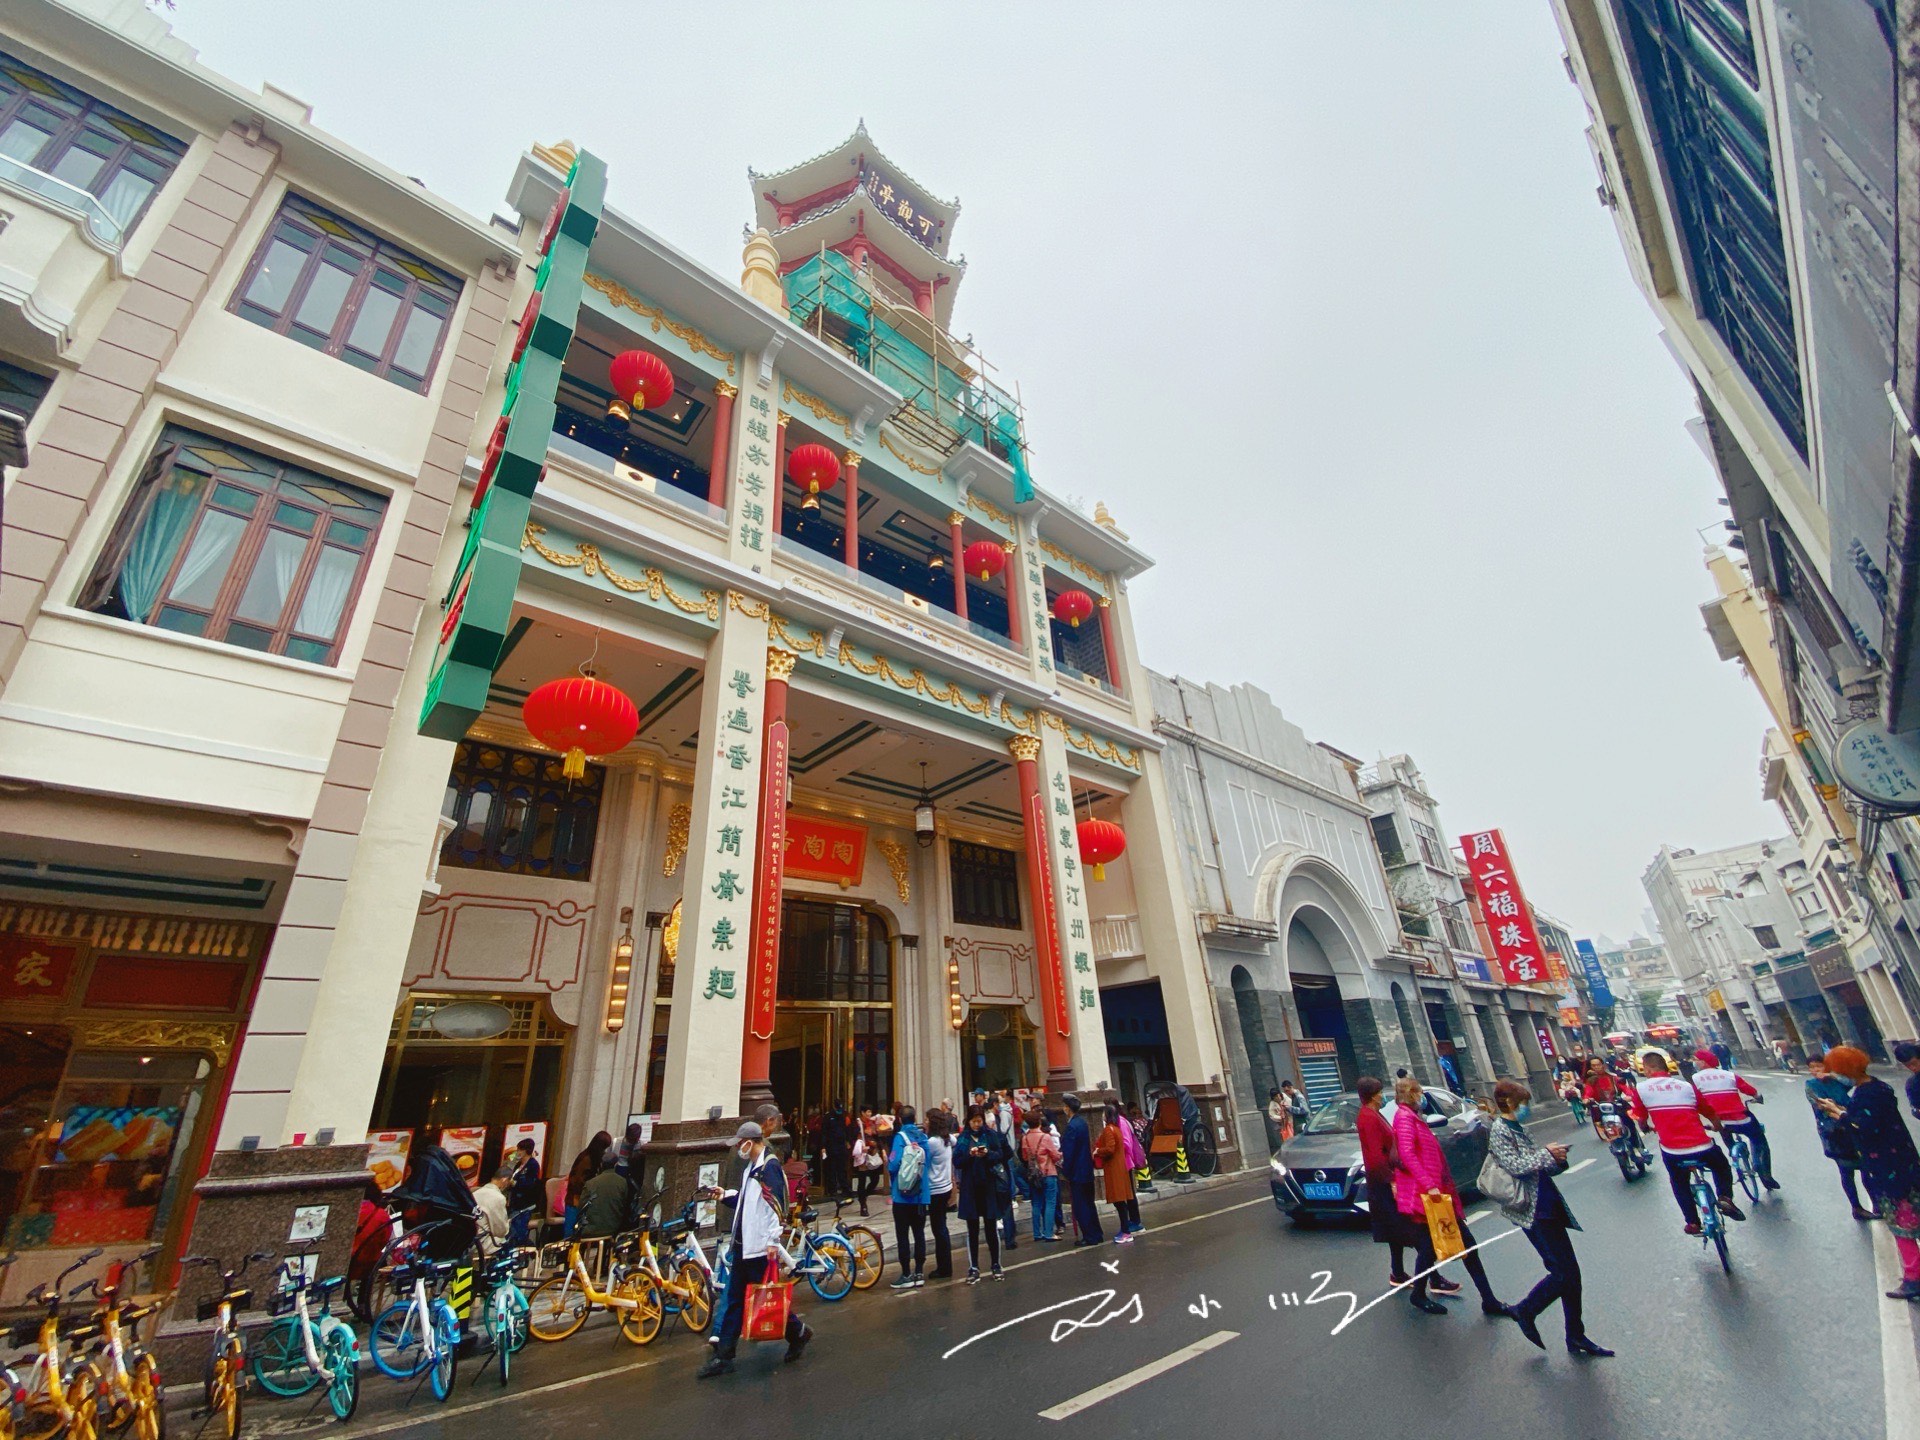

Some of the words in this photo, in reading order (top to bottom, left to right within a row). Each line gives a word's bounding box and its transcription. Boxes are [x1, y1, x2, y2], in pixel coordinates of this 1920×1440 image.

[703, 670, 756, 1001] 譽遍香江簡齋素麵
[1472, 832, 1538, 982] 周六福珠宝
